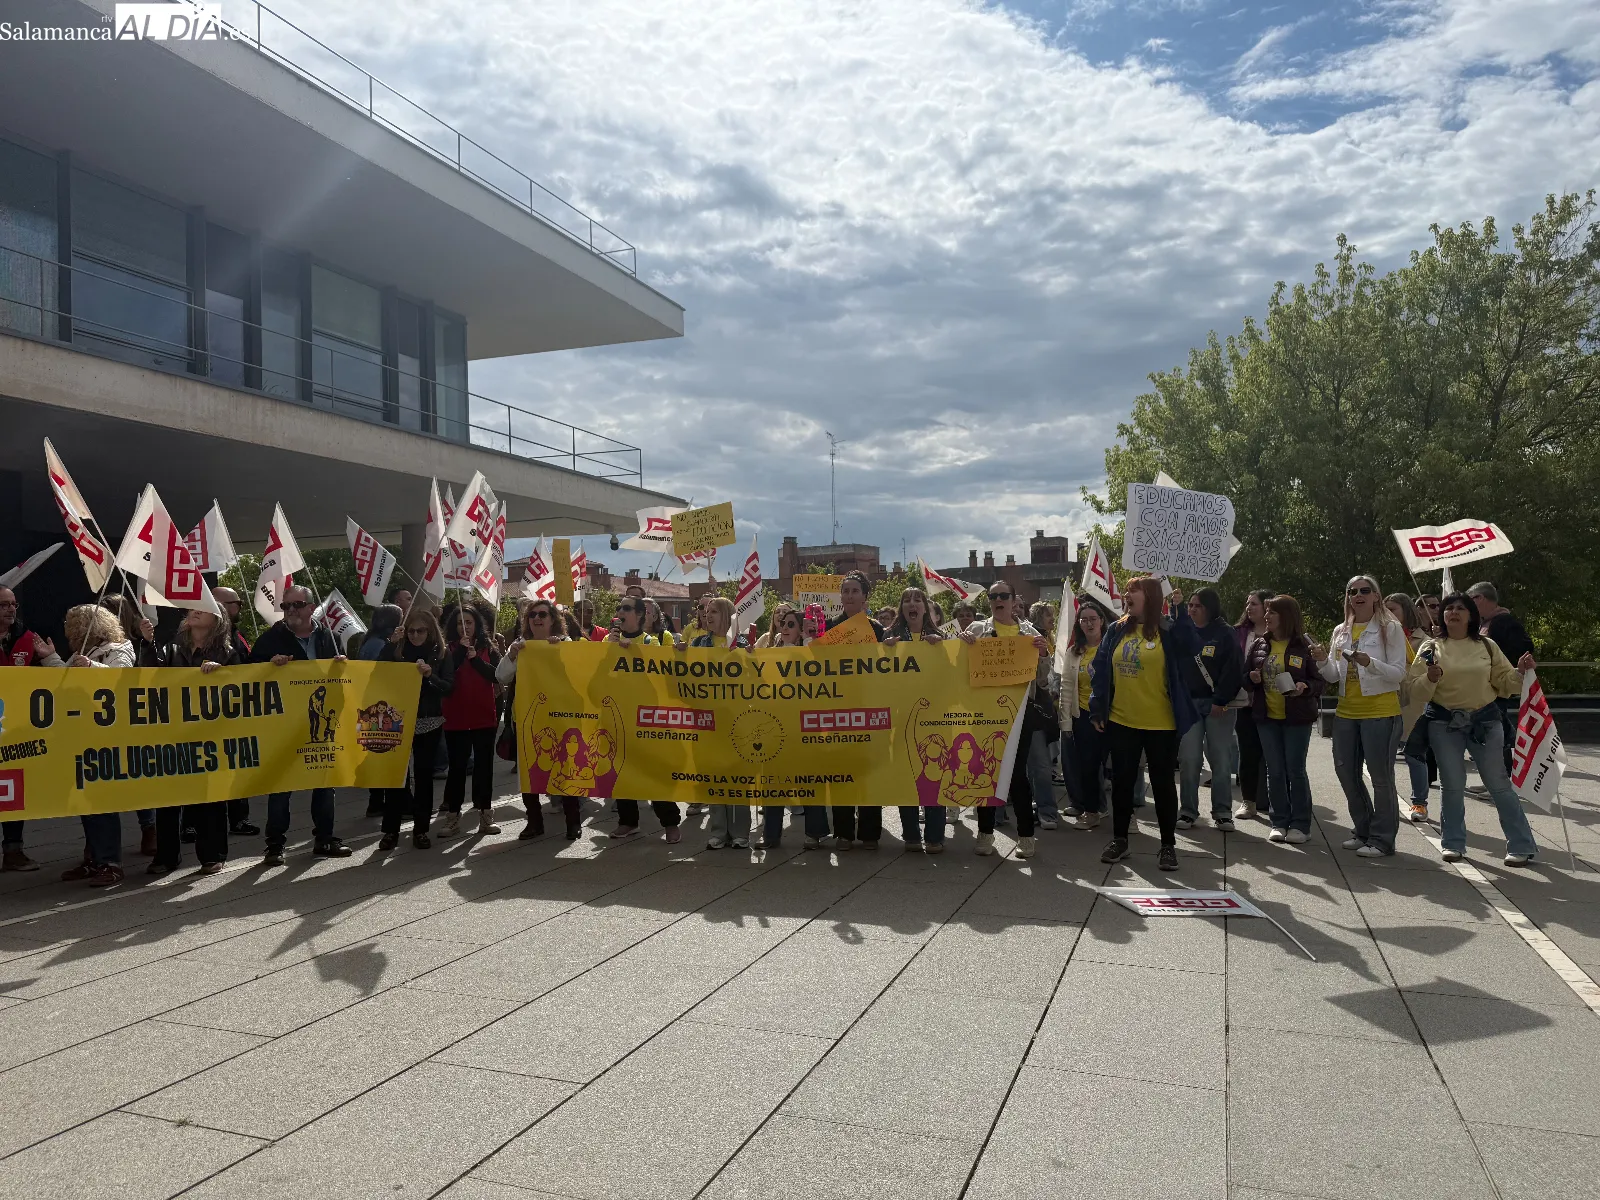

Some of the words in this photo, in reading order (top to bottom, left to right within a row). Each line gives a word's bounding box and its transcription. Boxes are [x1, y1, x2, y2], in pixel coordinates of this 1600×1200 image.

[1134, 485, 1227, 516] EDUCAMOS
[1140, 508, 1179, 530] CON
[1184, 514, 1229, 538] AMOR
[1415, 527, 1490, 553] CCOO
[1133, 549, 1170, 572] CON
[613, 656, 743, 678] ABANDONO
[751, 661, 765, 678] Y
[776, 655, 921, 678] VIOLENCIA
[677, 682, 844, 701] INSTITUCIONAL
[128, 686, 170, 726] EN
[181, 680, 284, 723] LUCHA
[548, 711, 574, 719] MENOS
[574, 712, 599, 720] RATIOS
[638, 708, 695, 728] CCOO
[802, 711, 867, 730] CCOO
[919, 719, 966, 727] CONDICIONES
[967, 718, 1009, 726] LABORALES
[943, 711, 972, 719] MEJORA
[635, 728, 699, 742] enseñanza
[801, 732, 872, 745] enseñanza
[75, 740, 220, 790] ¡SOLUCIONES
[222, 735, 261, 770] YA!
[304, 754, 319, 764] EN
[319, 752, 336, 763] PIE
[671, 771, 711, 783] SOMOS
[713, 774, 728, 784] LA
[732, 775, 756, 785] VOZ
[794, 774, 855, 784] INFANCIA
[707, 788, 725, 797] 0-3
[728, 789, 743, 798] ES
[745, 787, 816, 799] EDUCACIÓN
